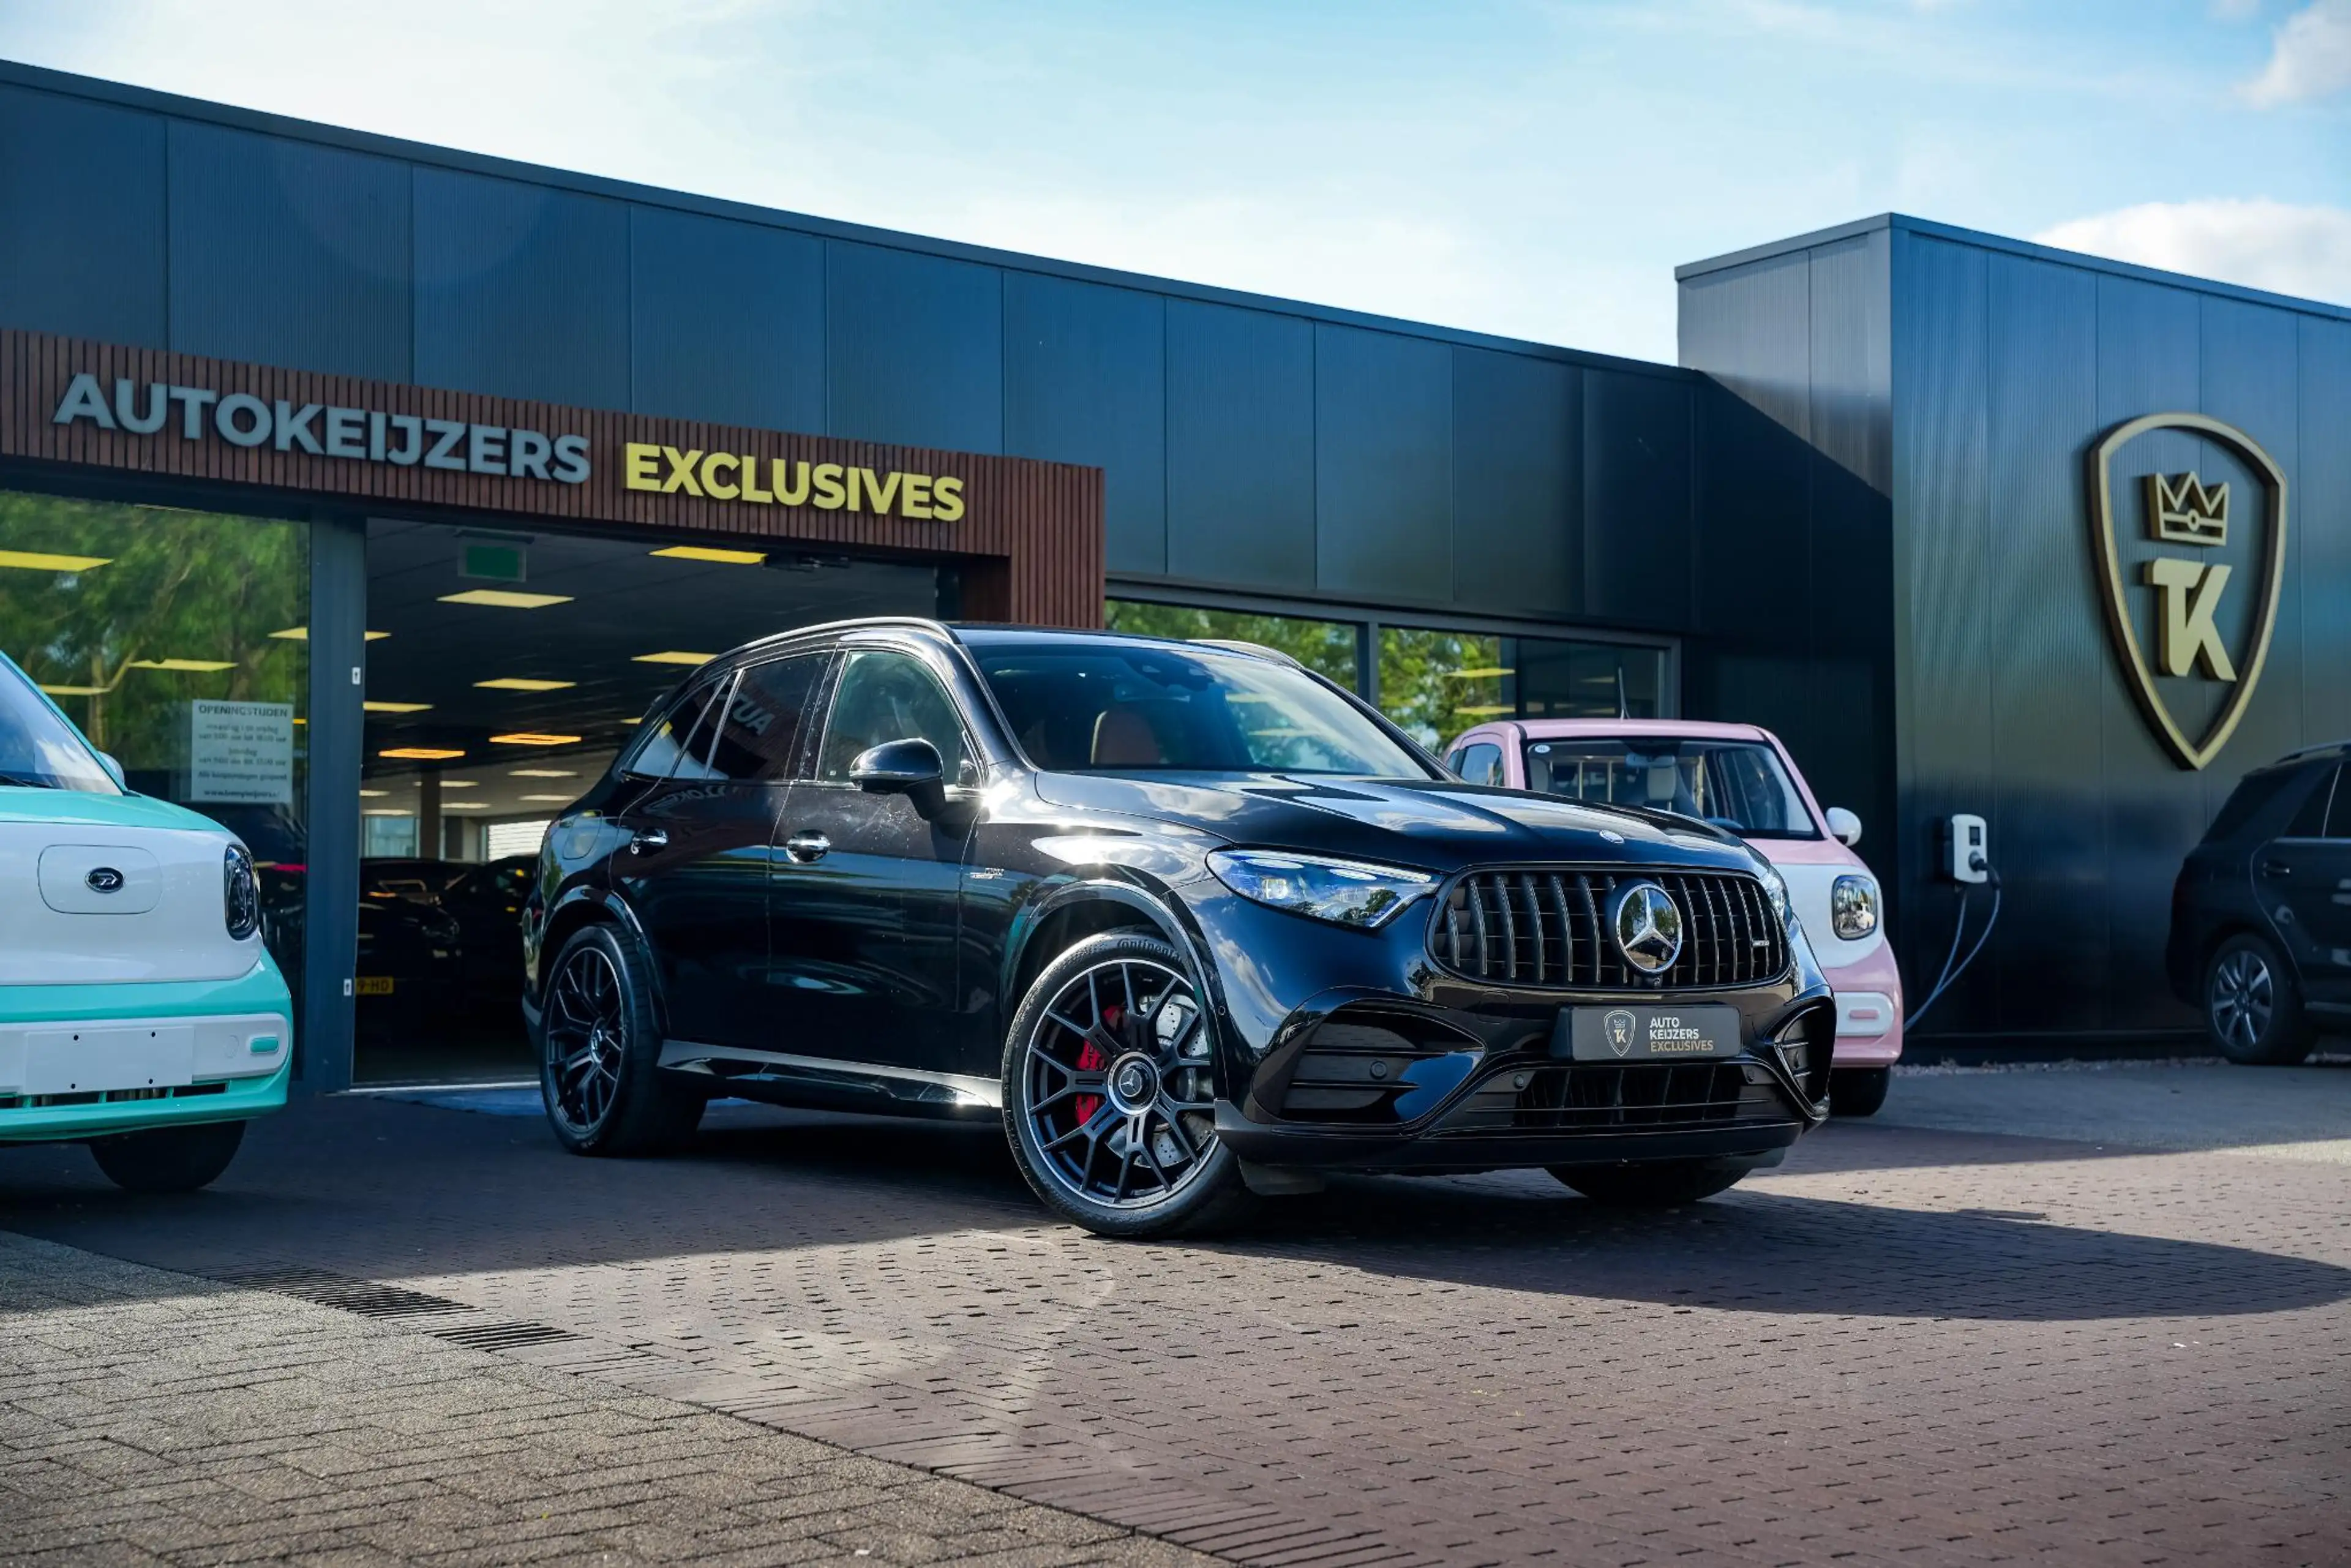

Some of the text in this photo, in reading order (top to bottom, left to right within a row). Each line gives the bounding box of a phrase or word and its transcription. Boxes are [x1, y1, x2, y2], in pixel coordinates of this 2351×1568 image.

[53, 372, 966, 522] AUTOKEIJZERS EXCLUSIVES
[2151, 557, 2237, 681] TK
[1117, 938, 1182, 962] Continenta
[1649, 1017, 1680, 1028] AUTO
[1649, 1029, 1700, 1040] KEIJZERS
[1651, 1040, 1714, 1052] EXCLUSIVES
